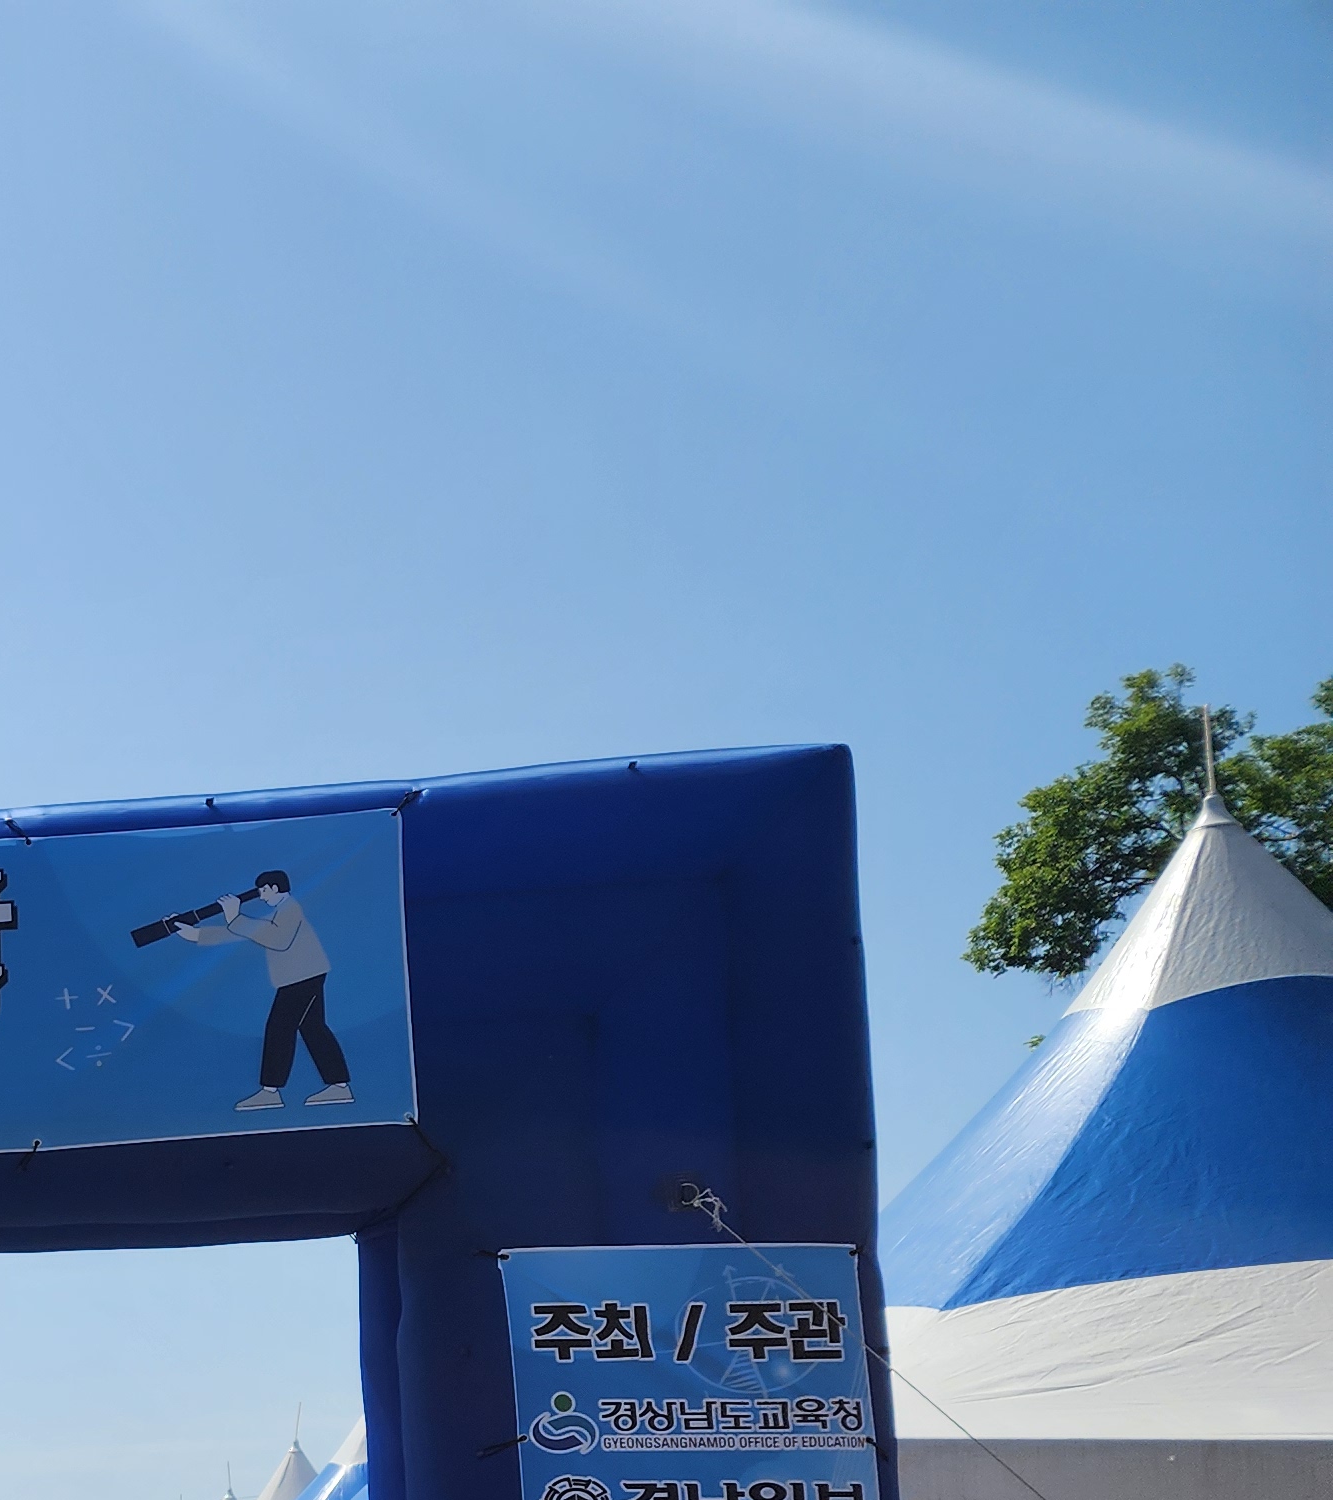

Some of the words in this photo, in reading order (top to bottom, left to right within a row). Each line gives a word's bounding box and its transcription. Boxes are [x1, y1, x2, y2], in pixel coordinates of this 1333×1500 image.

[532, 1302, 656, 1363] 주최
[727, 1301, 846, 1363] 주관
[599, 1397, 865, 1433] 경상남도교육청
[603, 1436, 735, 1450] GYEONGSANGNAMDO
[739, 1436, 780, 1449] OFFICE
[783, 1436, 800, 1449] OF
[802, 1435, 868, 1449] EDUCATION
